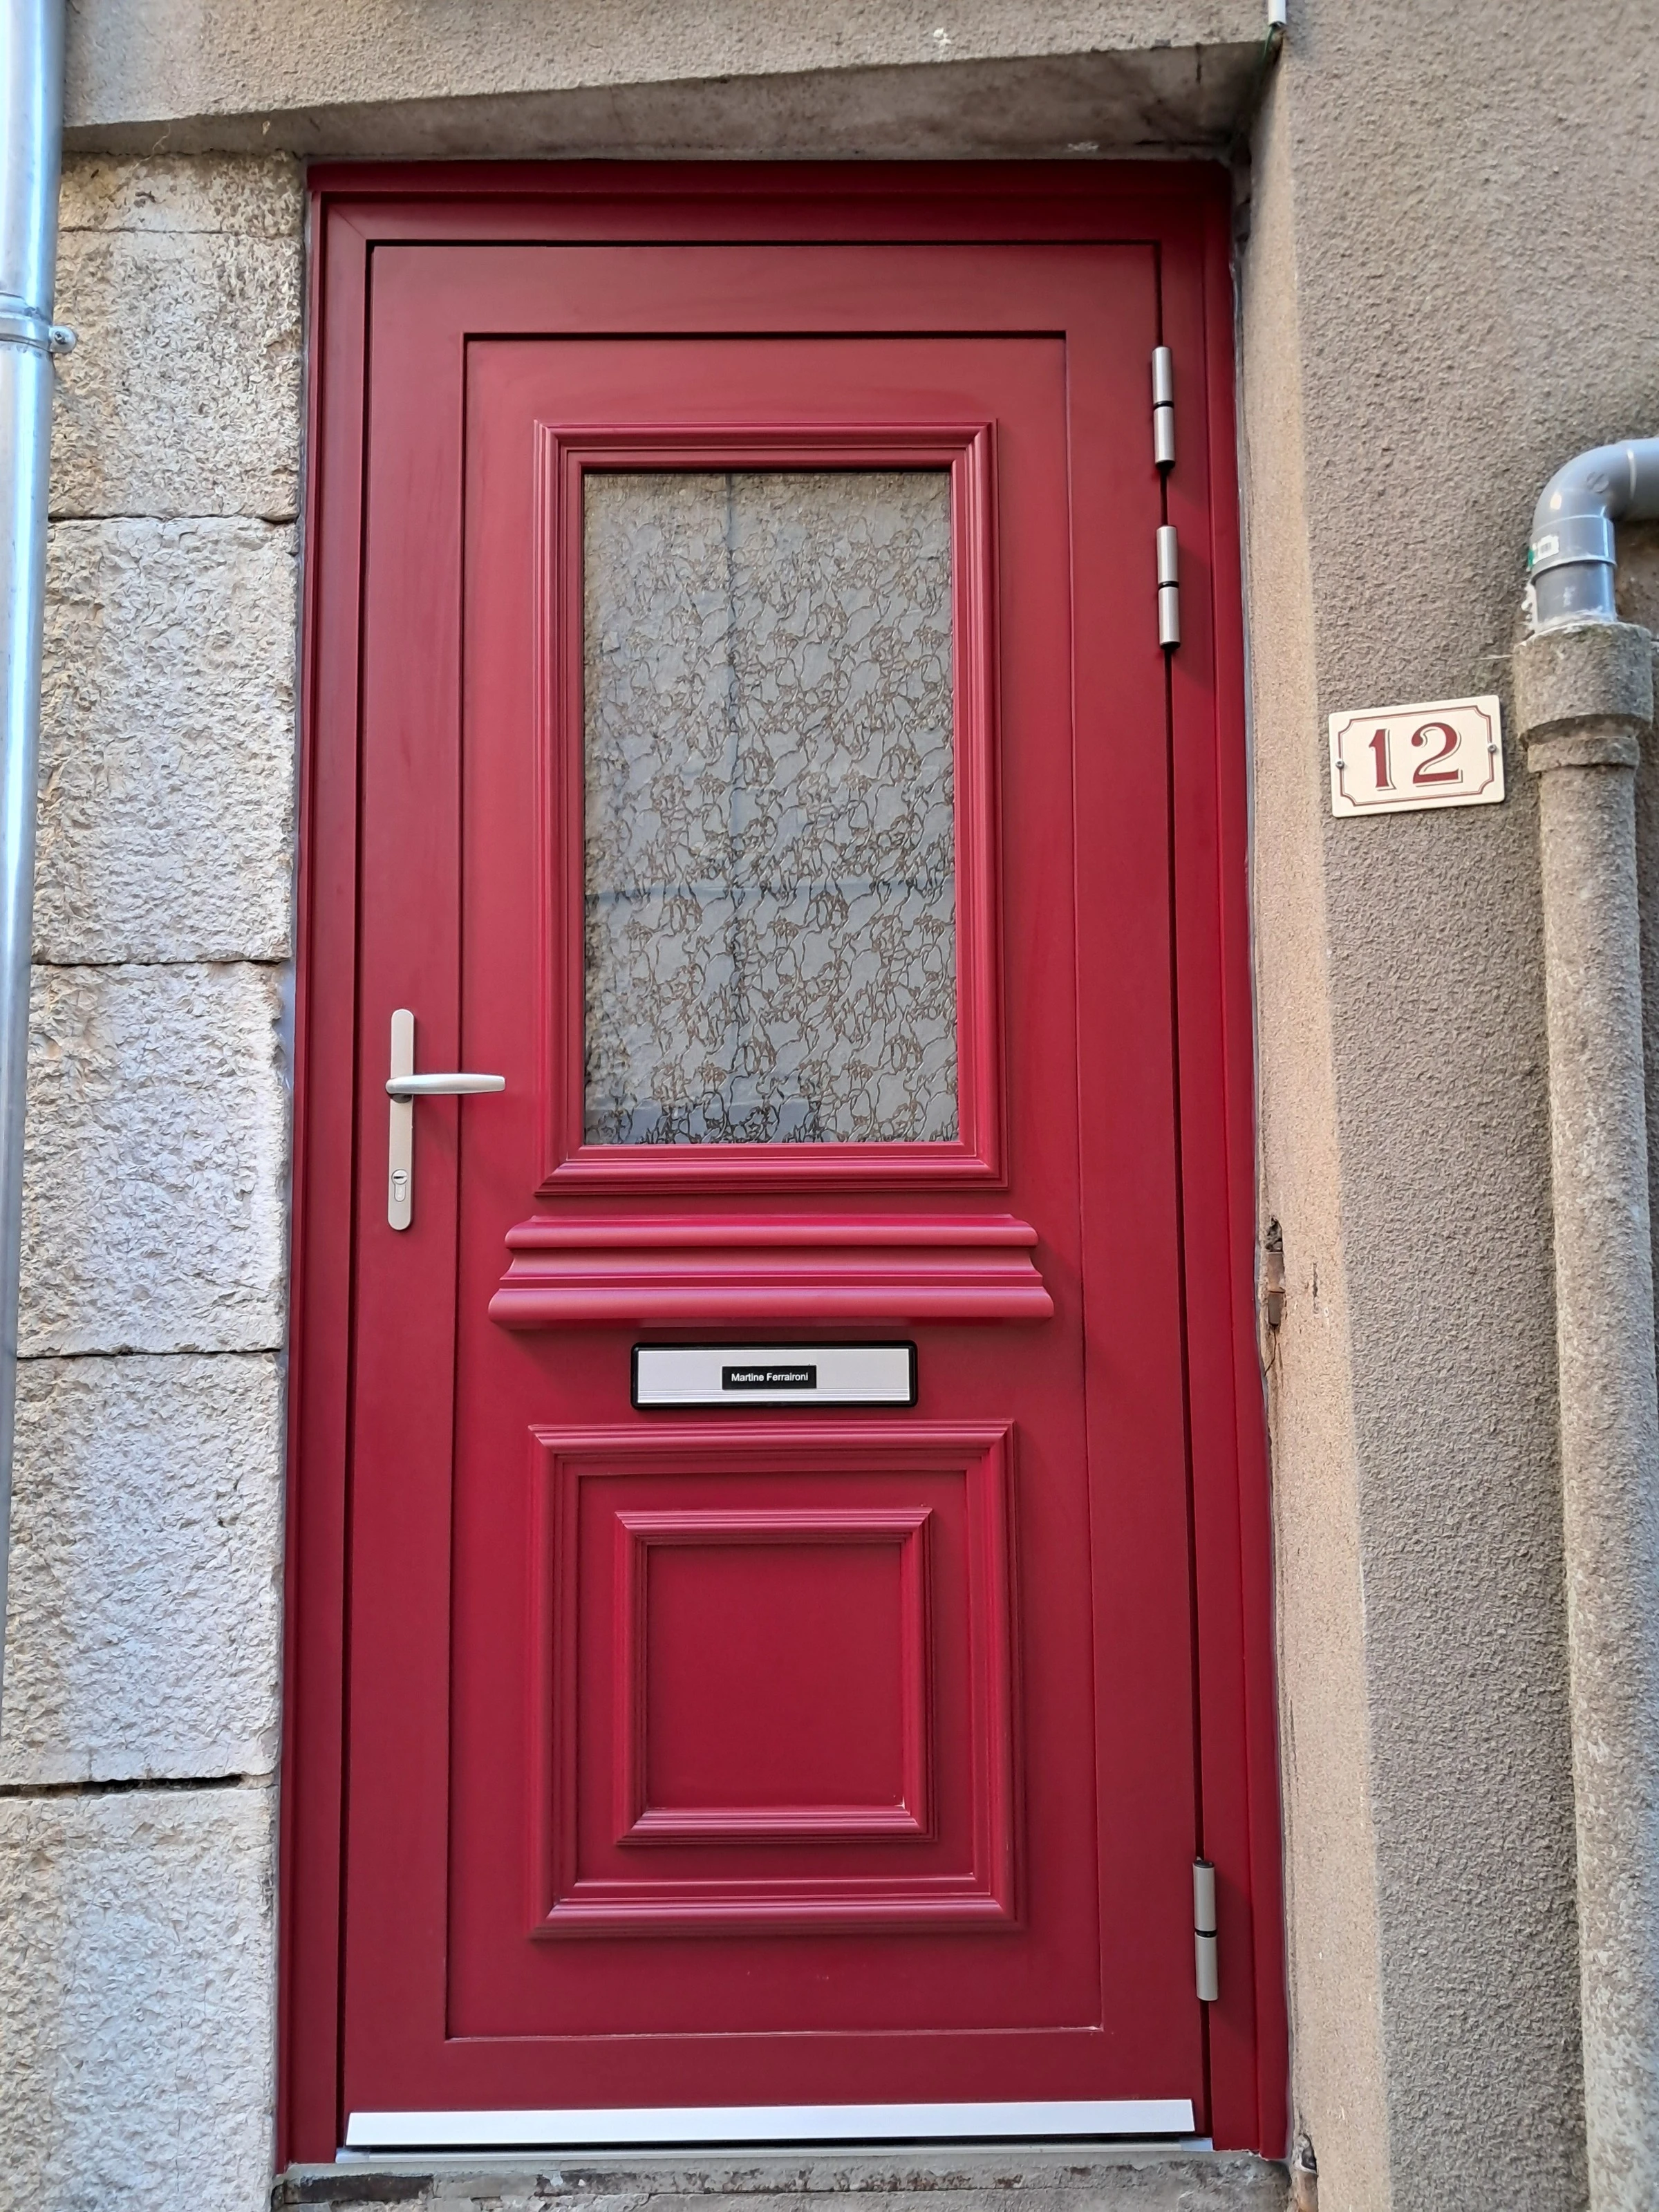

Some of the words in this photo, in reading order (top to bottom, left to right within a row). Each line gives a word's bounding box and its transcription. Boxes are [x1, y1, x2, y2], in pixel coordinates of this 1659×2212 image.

[1368, 722, 1463, 791] 12
[731, 1373, 765, 1381] Martine
[766, 1372, 809, 1381] Ferraironi
